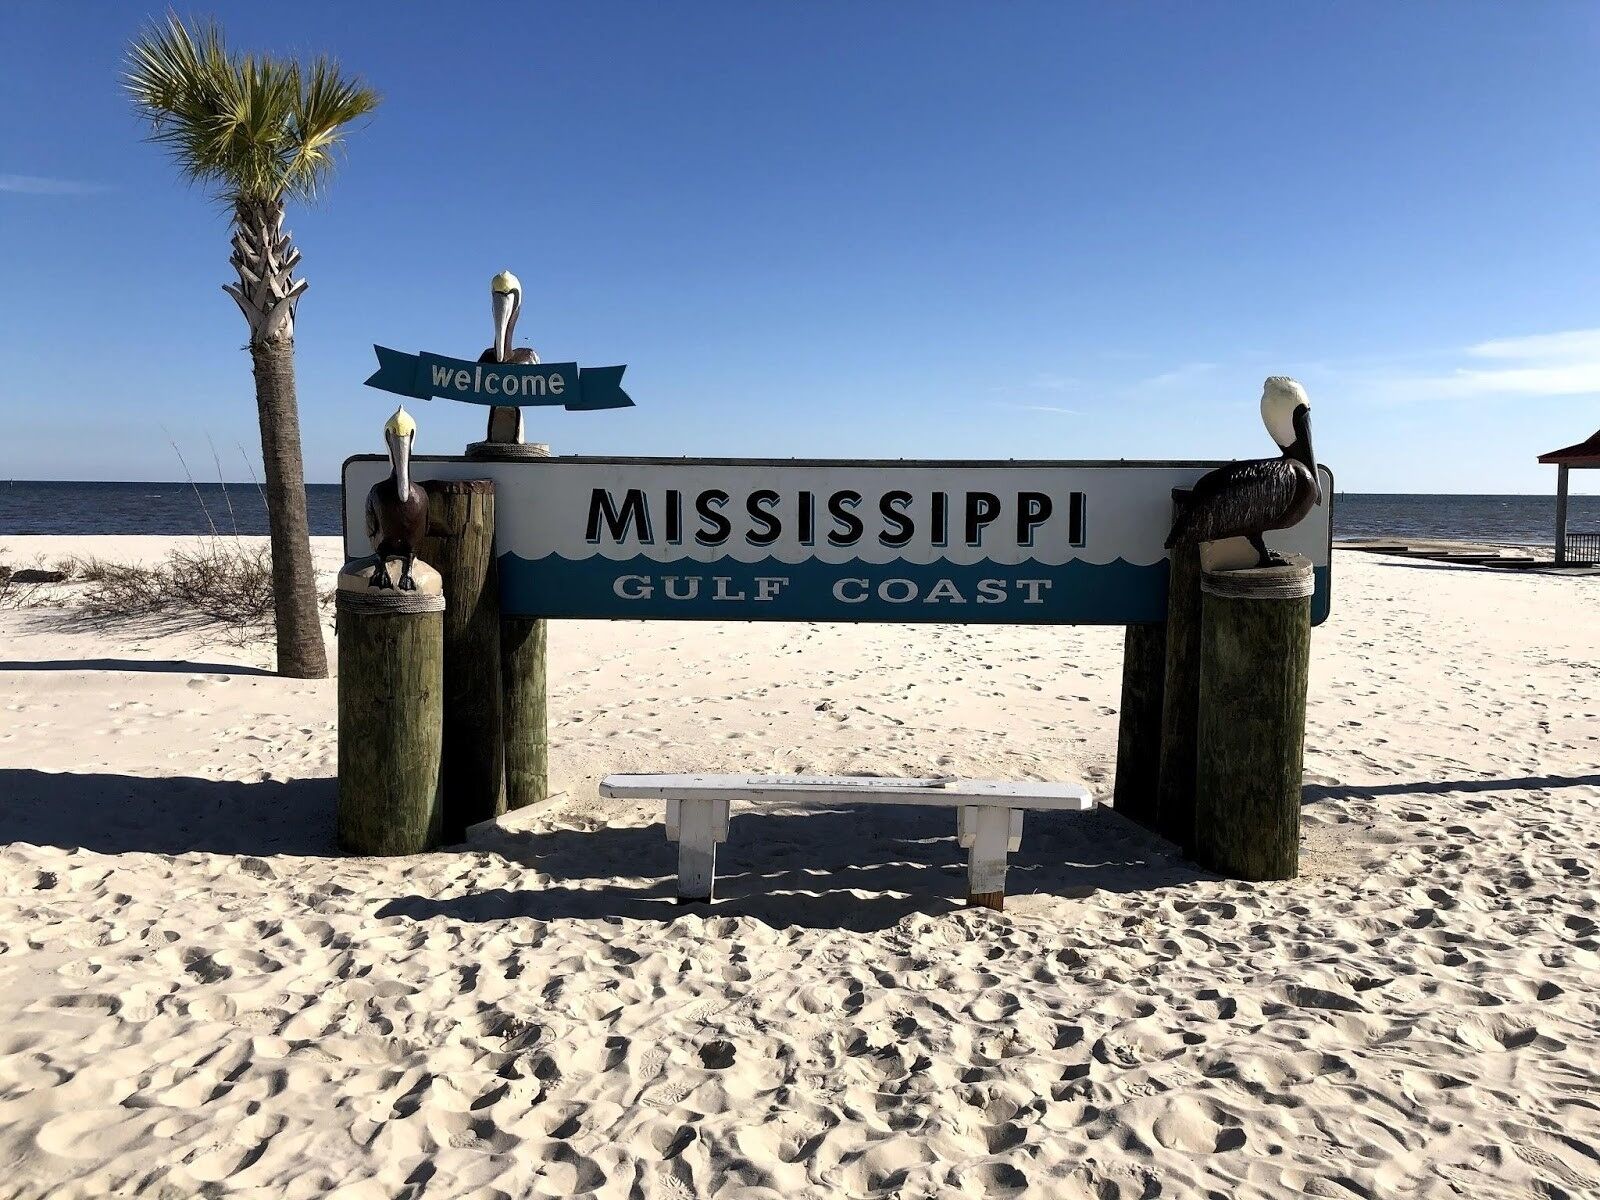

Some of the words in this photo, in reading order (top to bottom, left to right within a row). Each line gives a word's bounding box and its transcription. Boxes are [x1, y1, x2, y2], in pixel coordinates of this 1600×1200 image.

[431, 364, 566, 396] welcome
[585, 488, 1088, 549] MISSISSIPPI
[612, 574, 790, 602] GULF
[832, 577, 1054, 605] COAST
